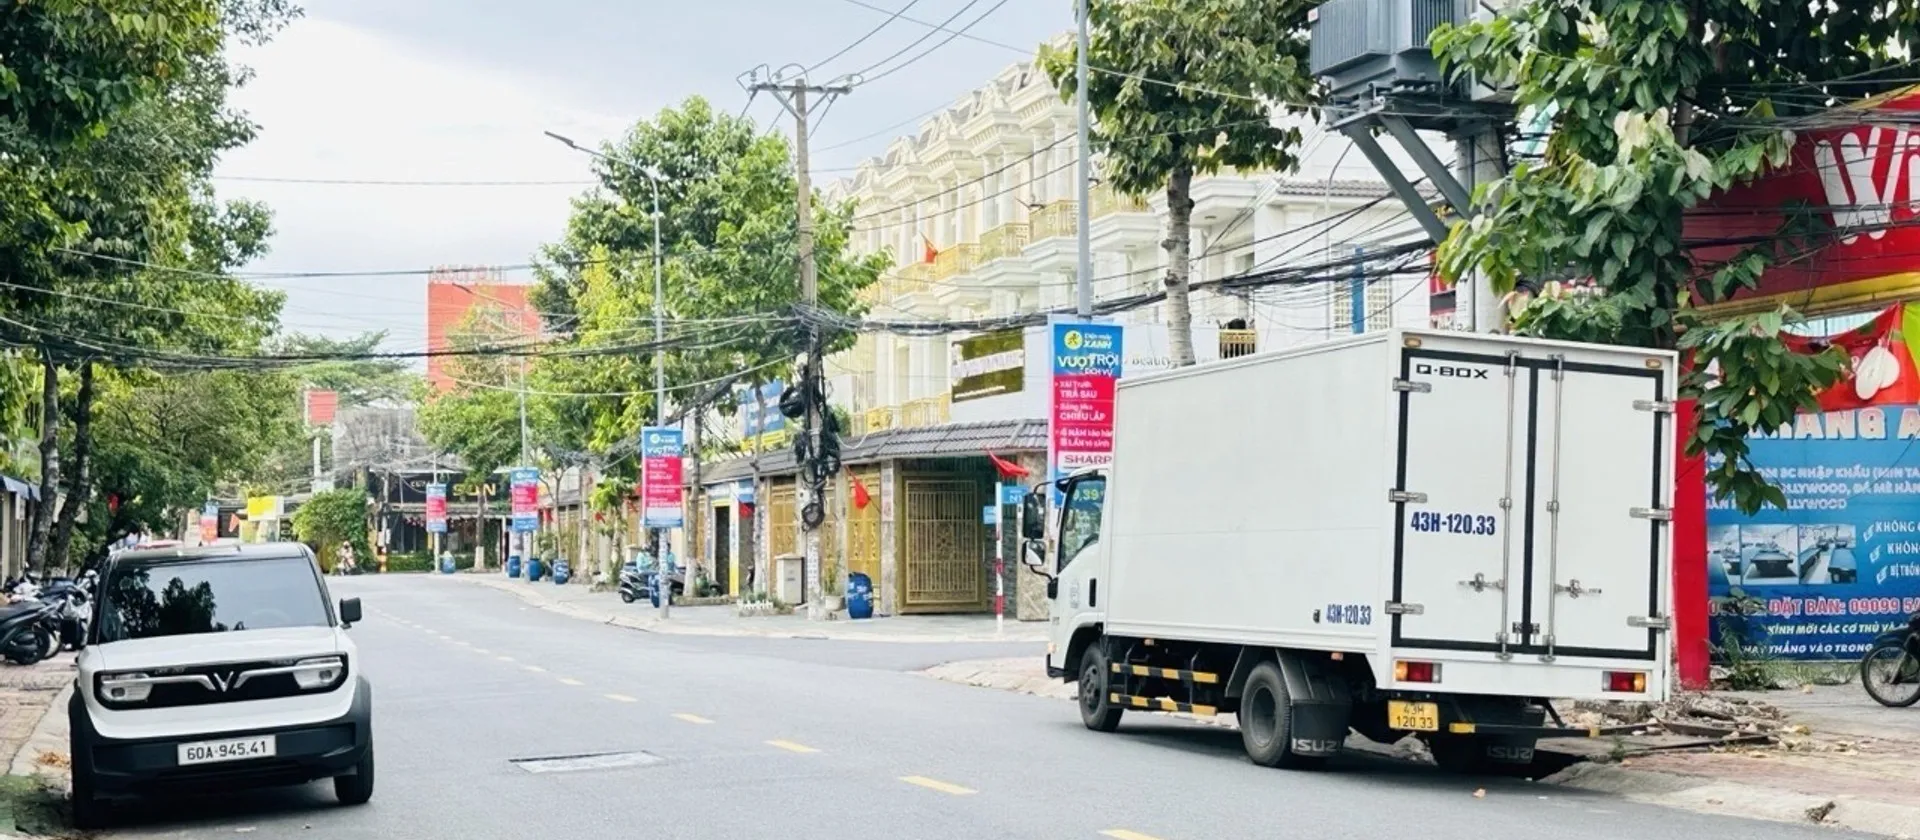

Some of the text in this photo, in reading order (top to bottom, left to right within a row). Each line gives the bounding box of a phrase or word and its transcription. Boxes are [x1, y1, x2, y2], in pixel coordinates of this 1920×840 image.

[1083, 339, 1112, 349] XANH
[1064, 455, 1112, 464] SHARP
[1411, 512, 1496, 535] 43H-120.33
[1887, 542, 1920, 554] KHÔN
[1850, 598, 1901, 615] 09099
[1403, 702, 1425, 715] 43H
